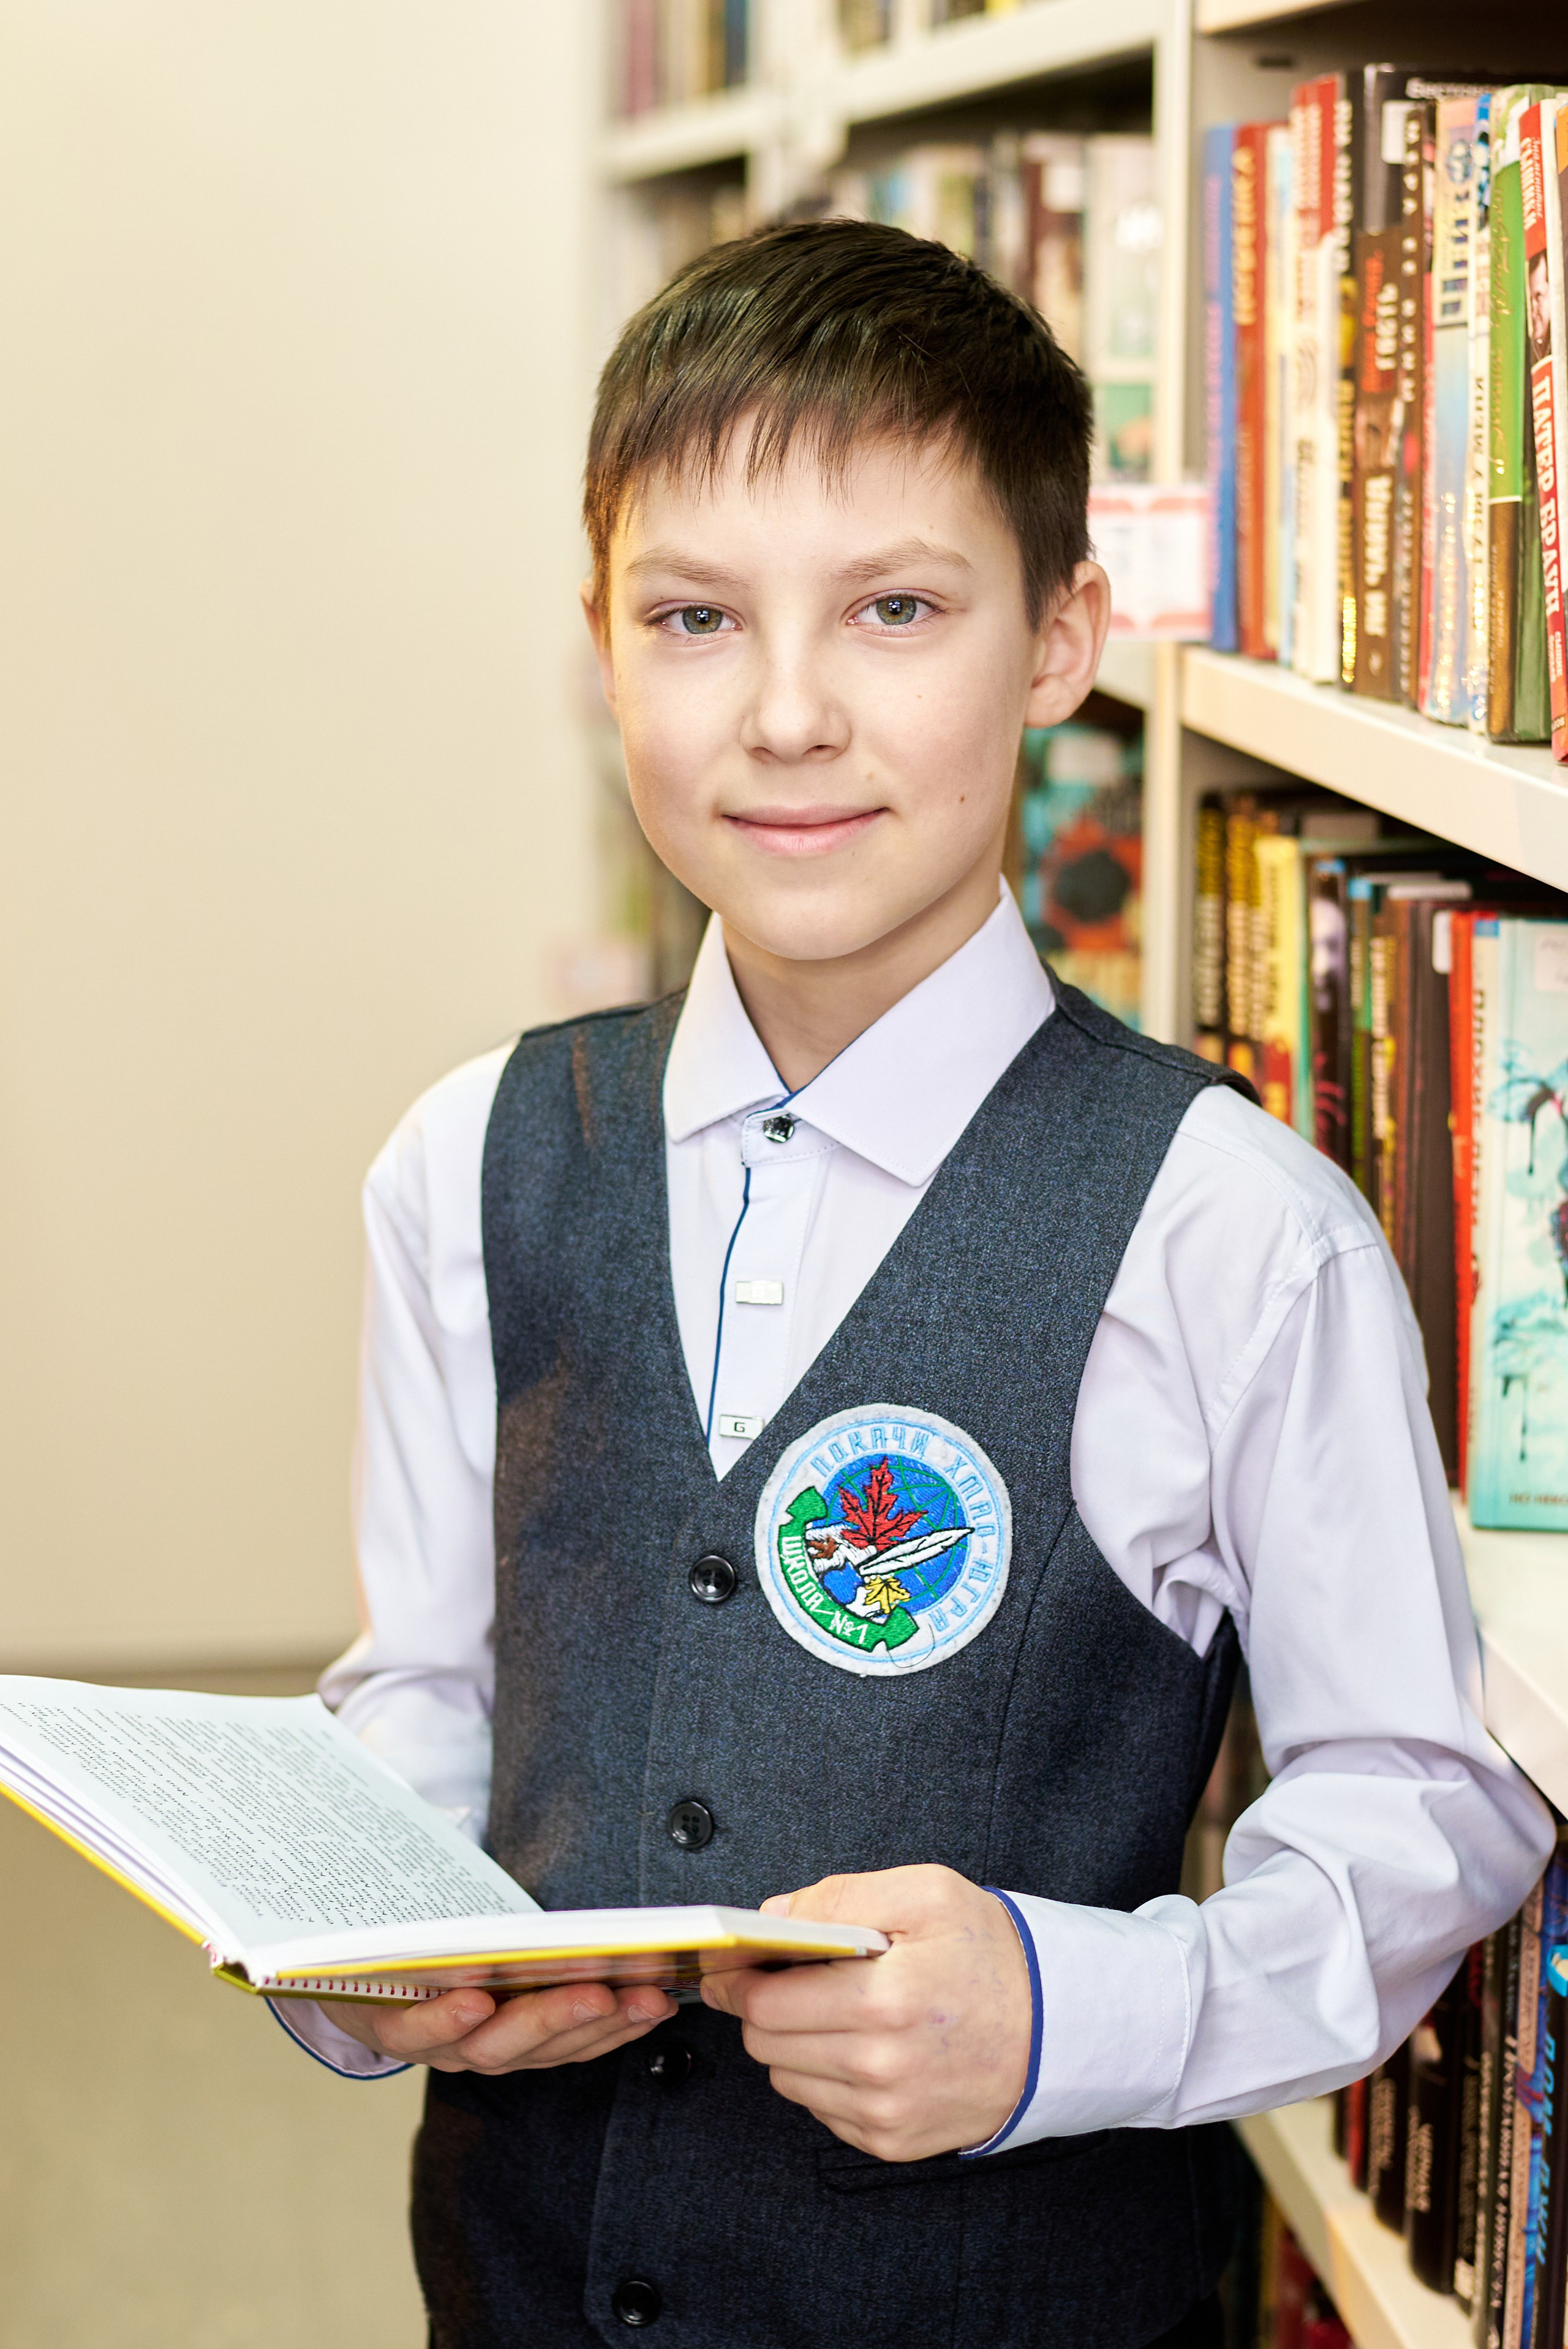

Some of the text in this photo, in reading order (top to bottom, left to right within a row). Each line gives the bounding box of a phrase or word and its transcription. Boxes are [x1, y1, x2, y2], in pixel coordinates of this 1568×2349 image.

[1532, 376, 1559, 617] ПАТЕР БРАУН
[810, 1426, 935, 1478] ПОКАЧИ
[781, 1536, 823, 1613] ШКОЛА
[927, 1454, 996, 1633] ХМАО-ЮГРА
